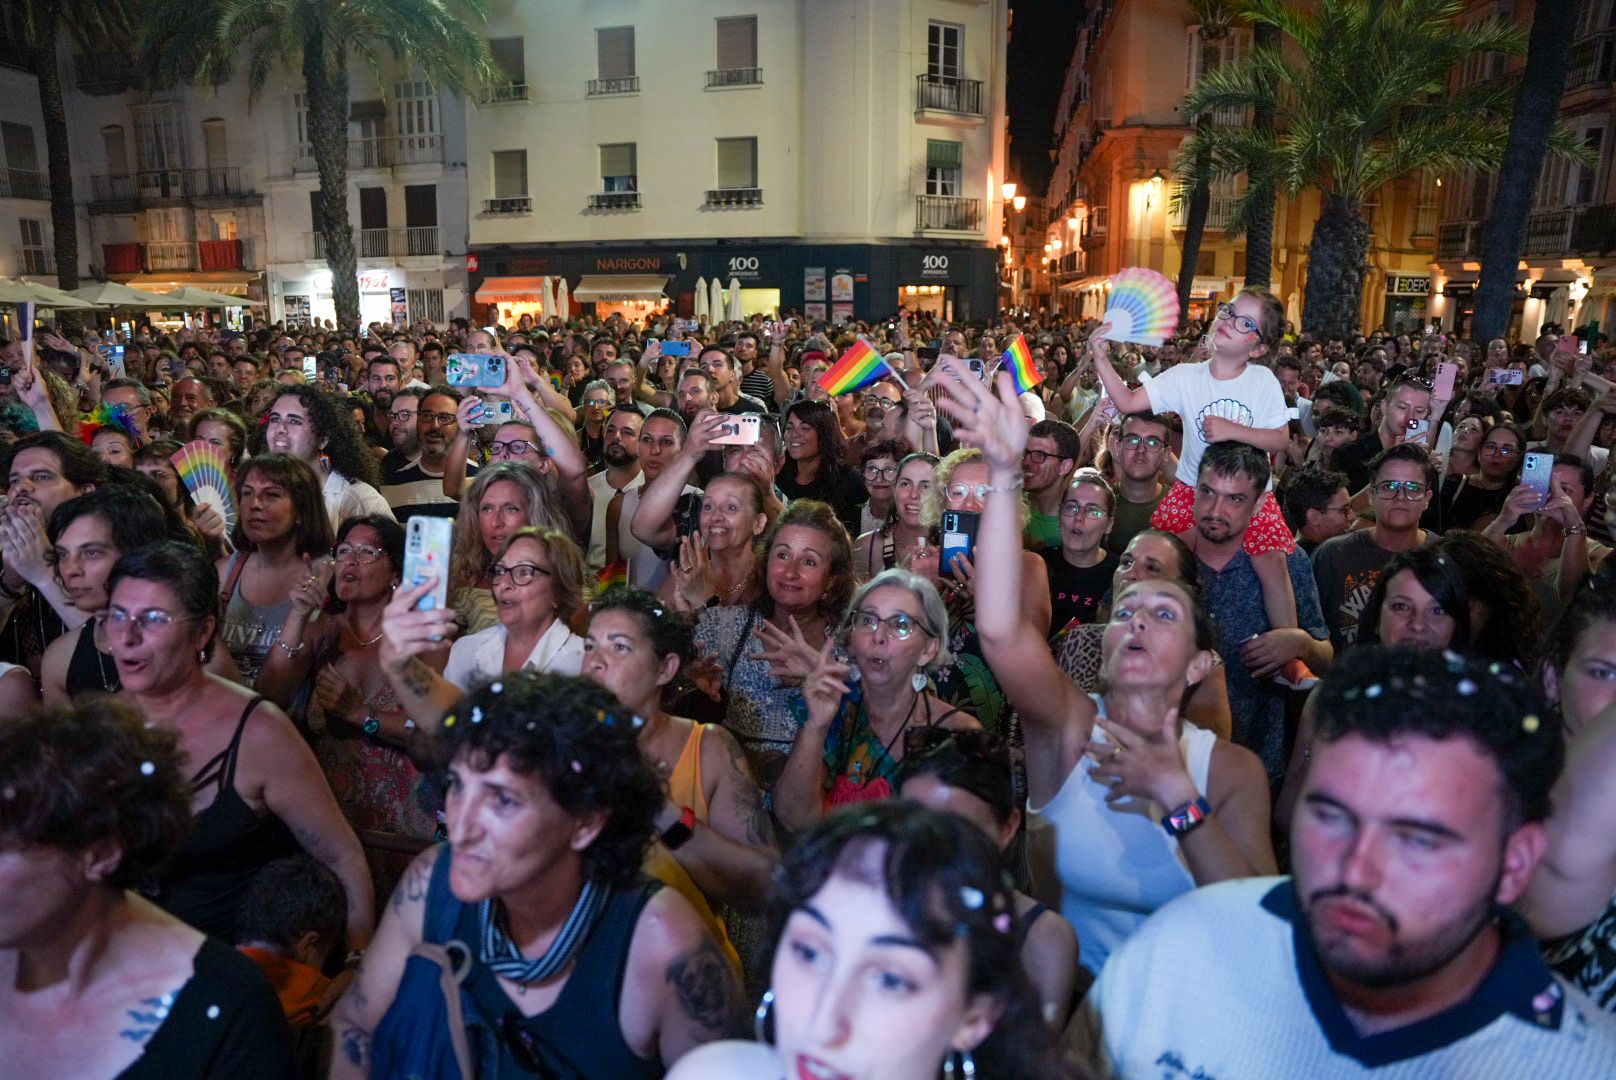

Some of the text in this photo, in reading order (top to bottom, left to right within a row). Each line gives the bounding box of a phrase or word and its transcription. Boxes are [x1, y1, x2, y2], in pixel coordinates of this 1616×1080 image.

[597, 257, 660, 270] NARIGONI
[728, 256, 759, 270] 100
[922, 255, 948, 269] 100
[360, 275, 389, 289] 1906
